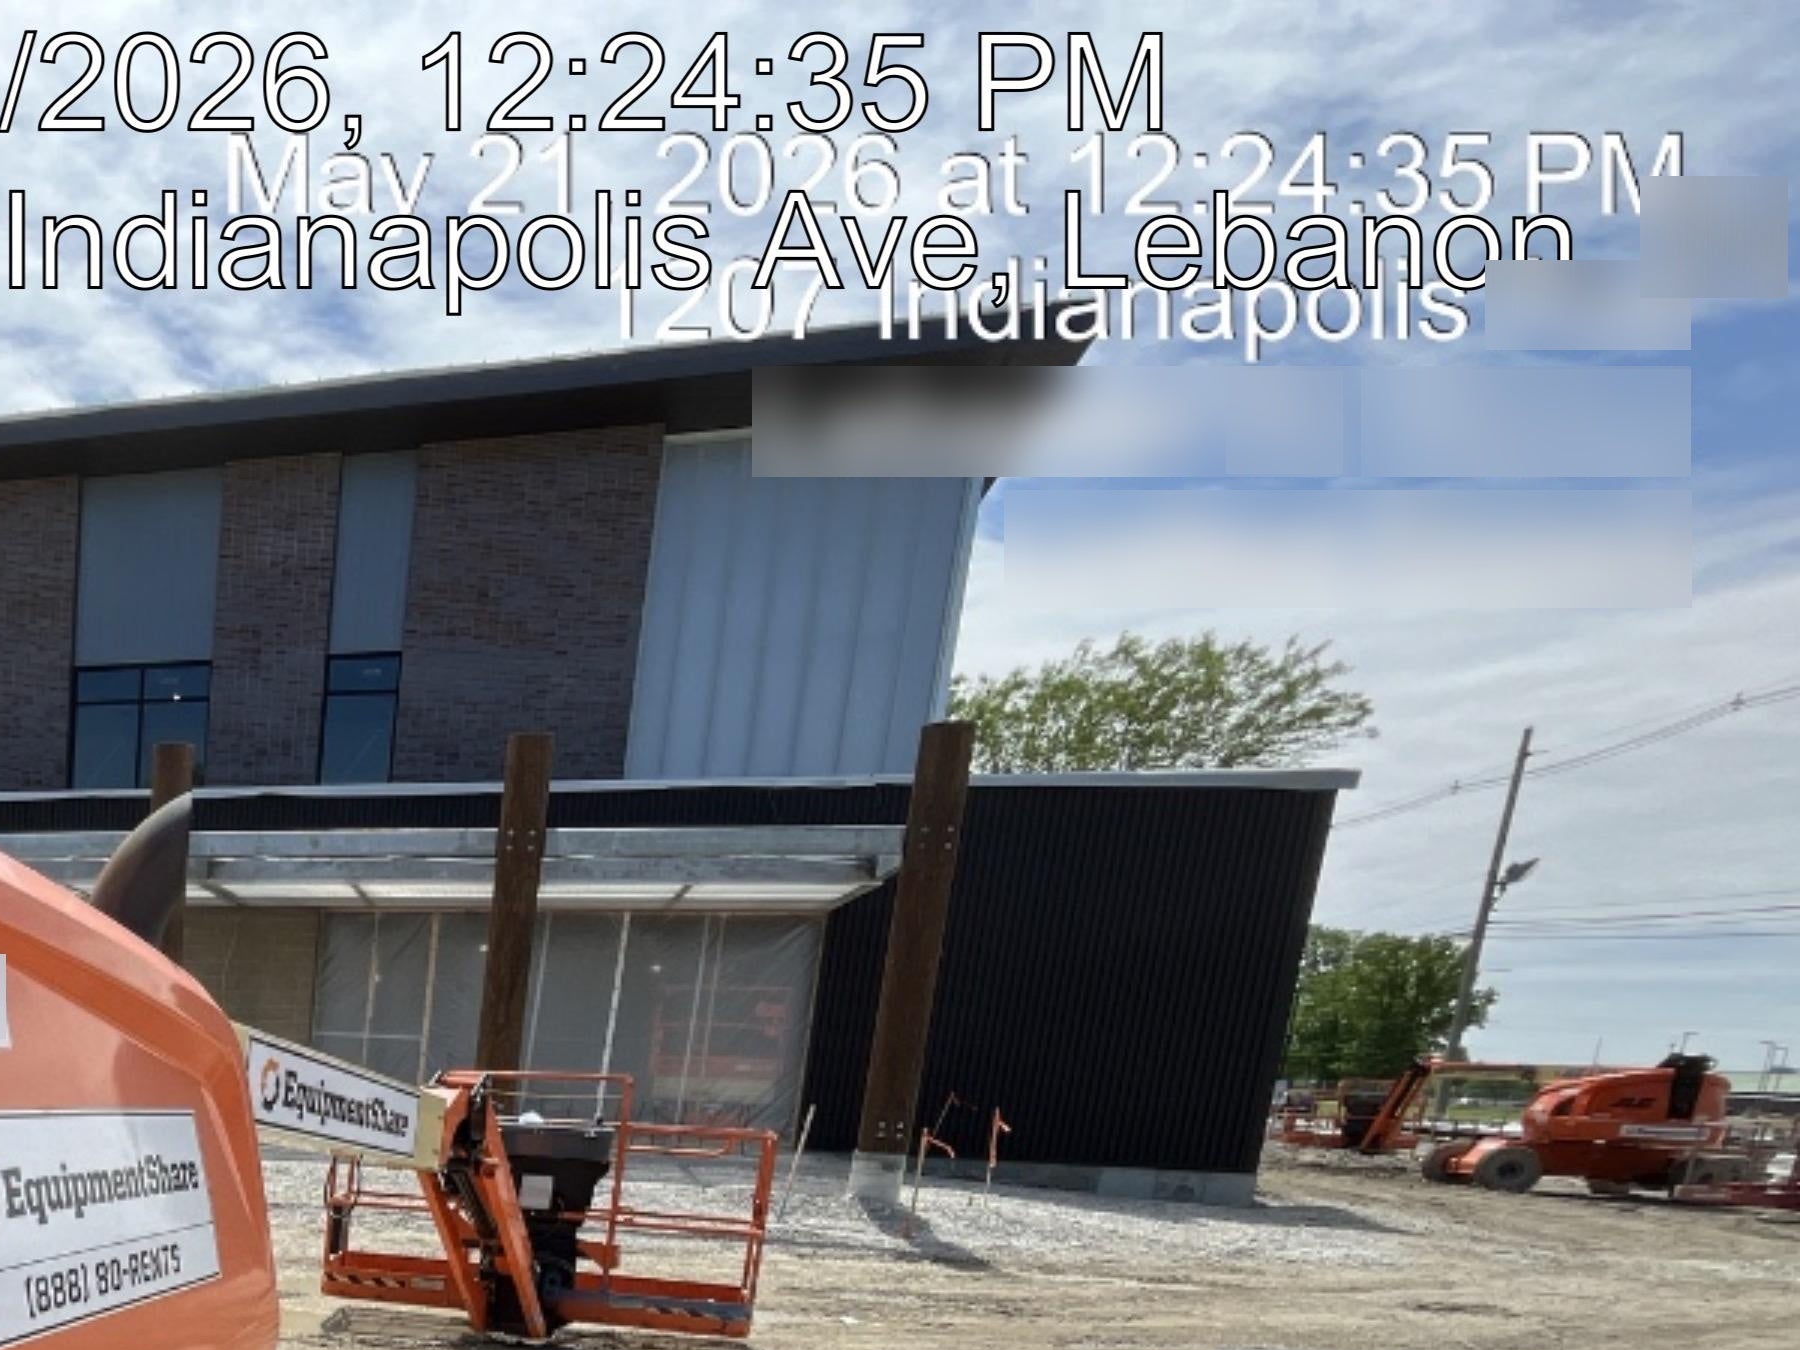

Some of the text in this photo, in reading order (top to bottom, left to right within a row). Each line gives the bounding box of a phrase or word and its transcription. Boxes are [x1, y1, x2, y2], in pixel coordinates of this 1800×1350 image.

[282, 1070, 410, 1138] EquipmentShare
[0, 1154, 199, 1225] EquipmentShare
[24, 1263, 89, 1319] (888)
